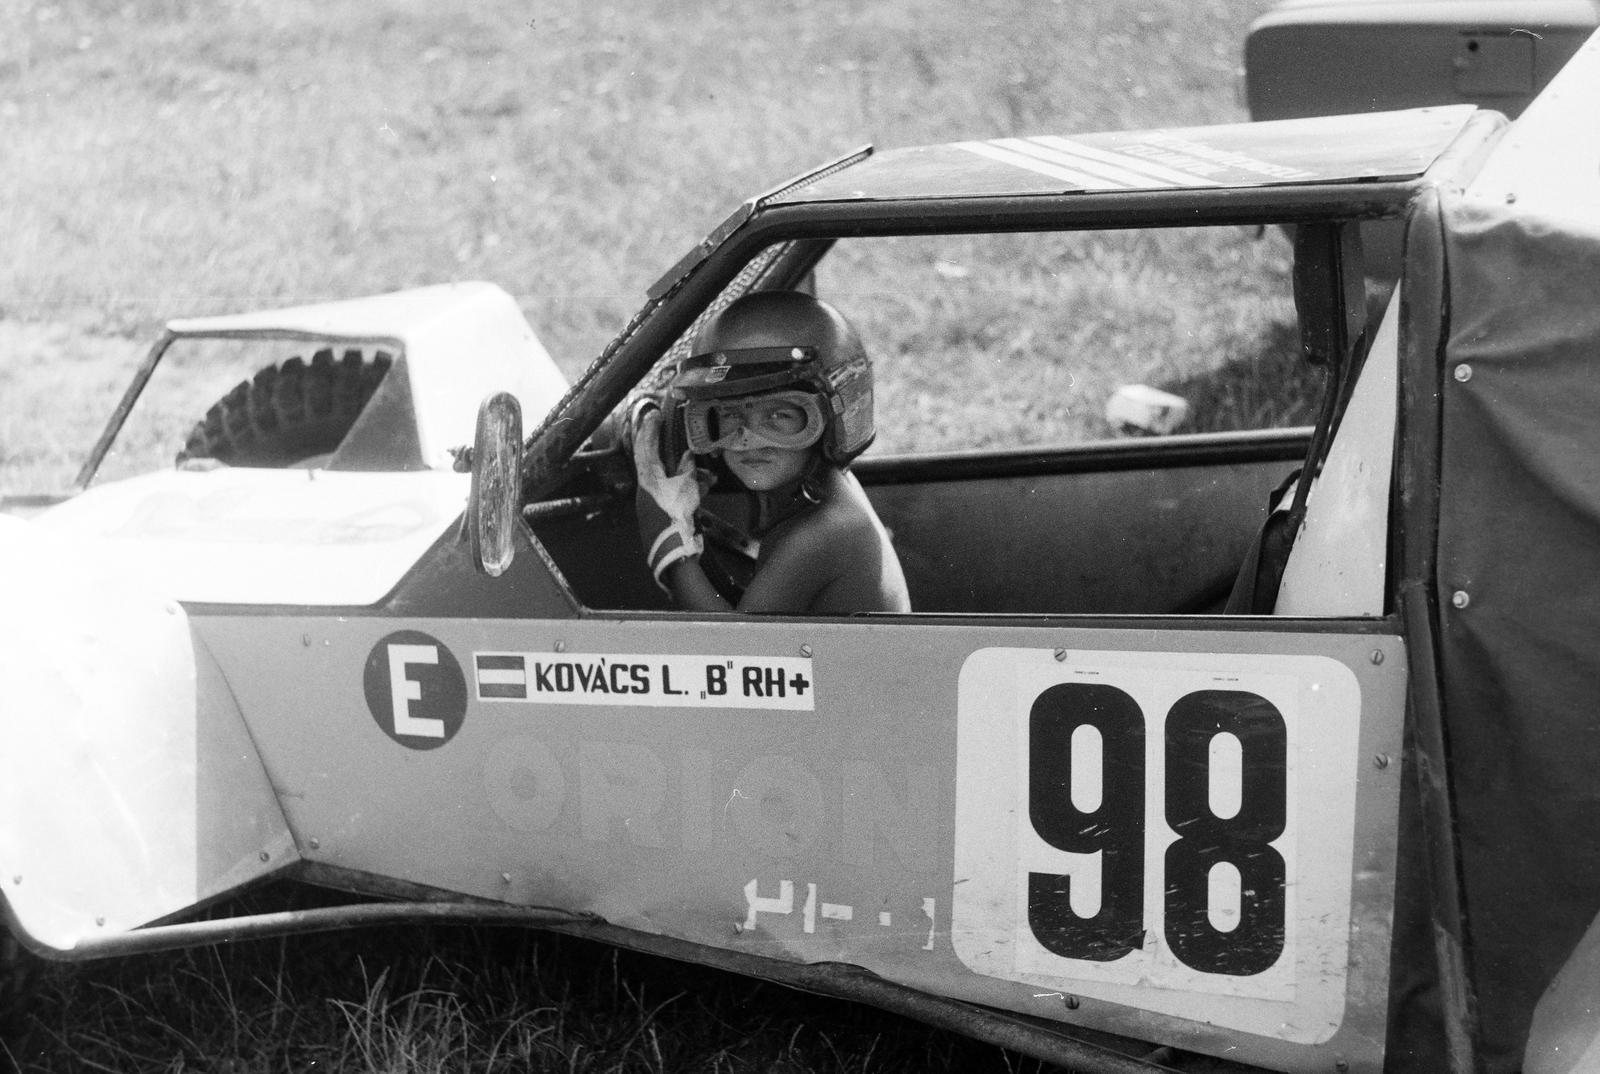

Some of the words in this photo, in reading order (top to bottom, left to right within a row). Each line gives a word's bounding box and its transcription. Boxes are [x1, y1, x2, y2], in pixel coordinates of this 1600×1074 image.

[386, 643, 445, 738] E
[535, 657, 651, 695] KOVÁCS
[661, 664, 690, 696] L.
[742, 666, 810, 698] RH+
[483, 735, 939, 871] ORION
[1027, 682, 1288, 977] 98
